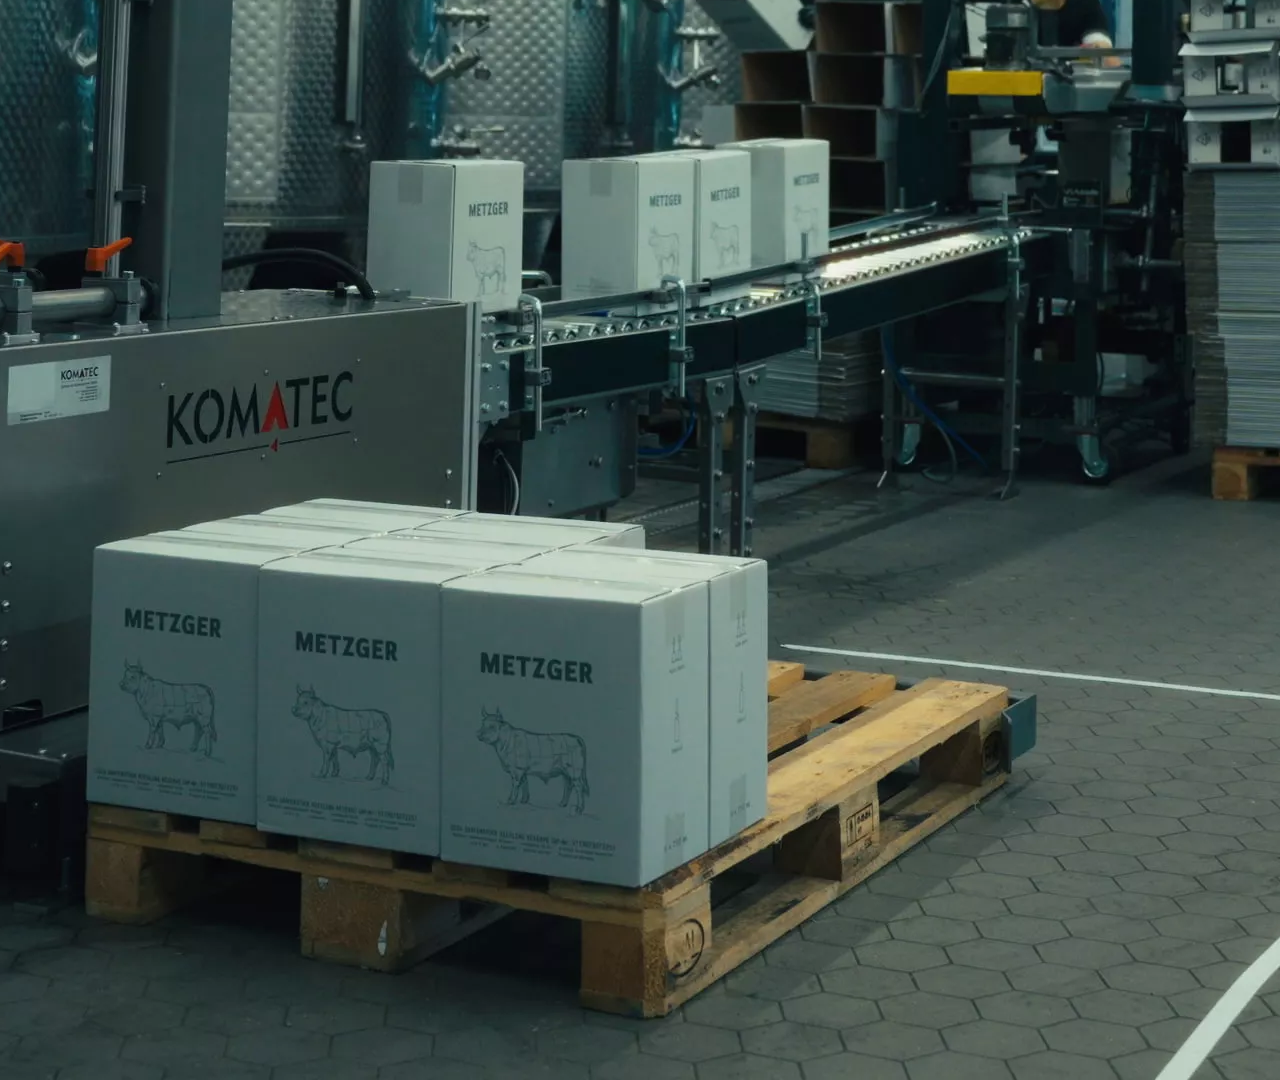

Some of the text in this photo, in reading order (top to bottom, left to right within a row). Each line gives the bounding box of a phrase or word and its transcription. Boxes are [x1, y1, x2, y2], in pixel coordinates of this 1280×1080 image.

[793, 172, 820, 186] METZGER
[649, 193, 682, 208] METZGER
[710, 186, 740, 203] METZGER
[468, 201, 509, 218] METZGER
[60, 366, 99, 380] KOMATEC
[166, 371, 353, 449] KOMATEC
[123, 607, 222, 639] METZGER
[295, 630, 398, 663] METZGER
[480, 651, 593, 685] METZGER
